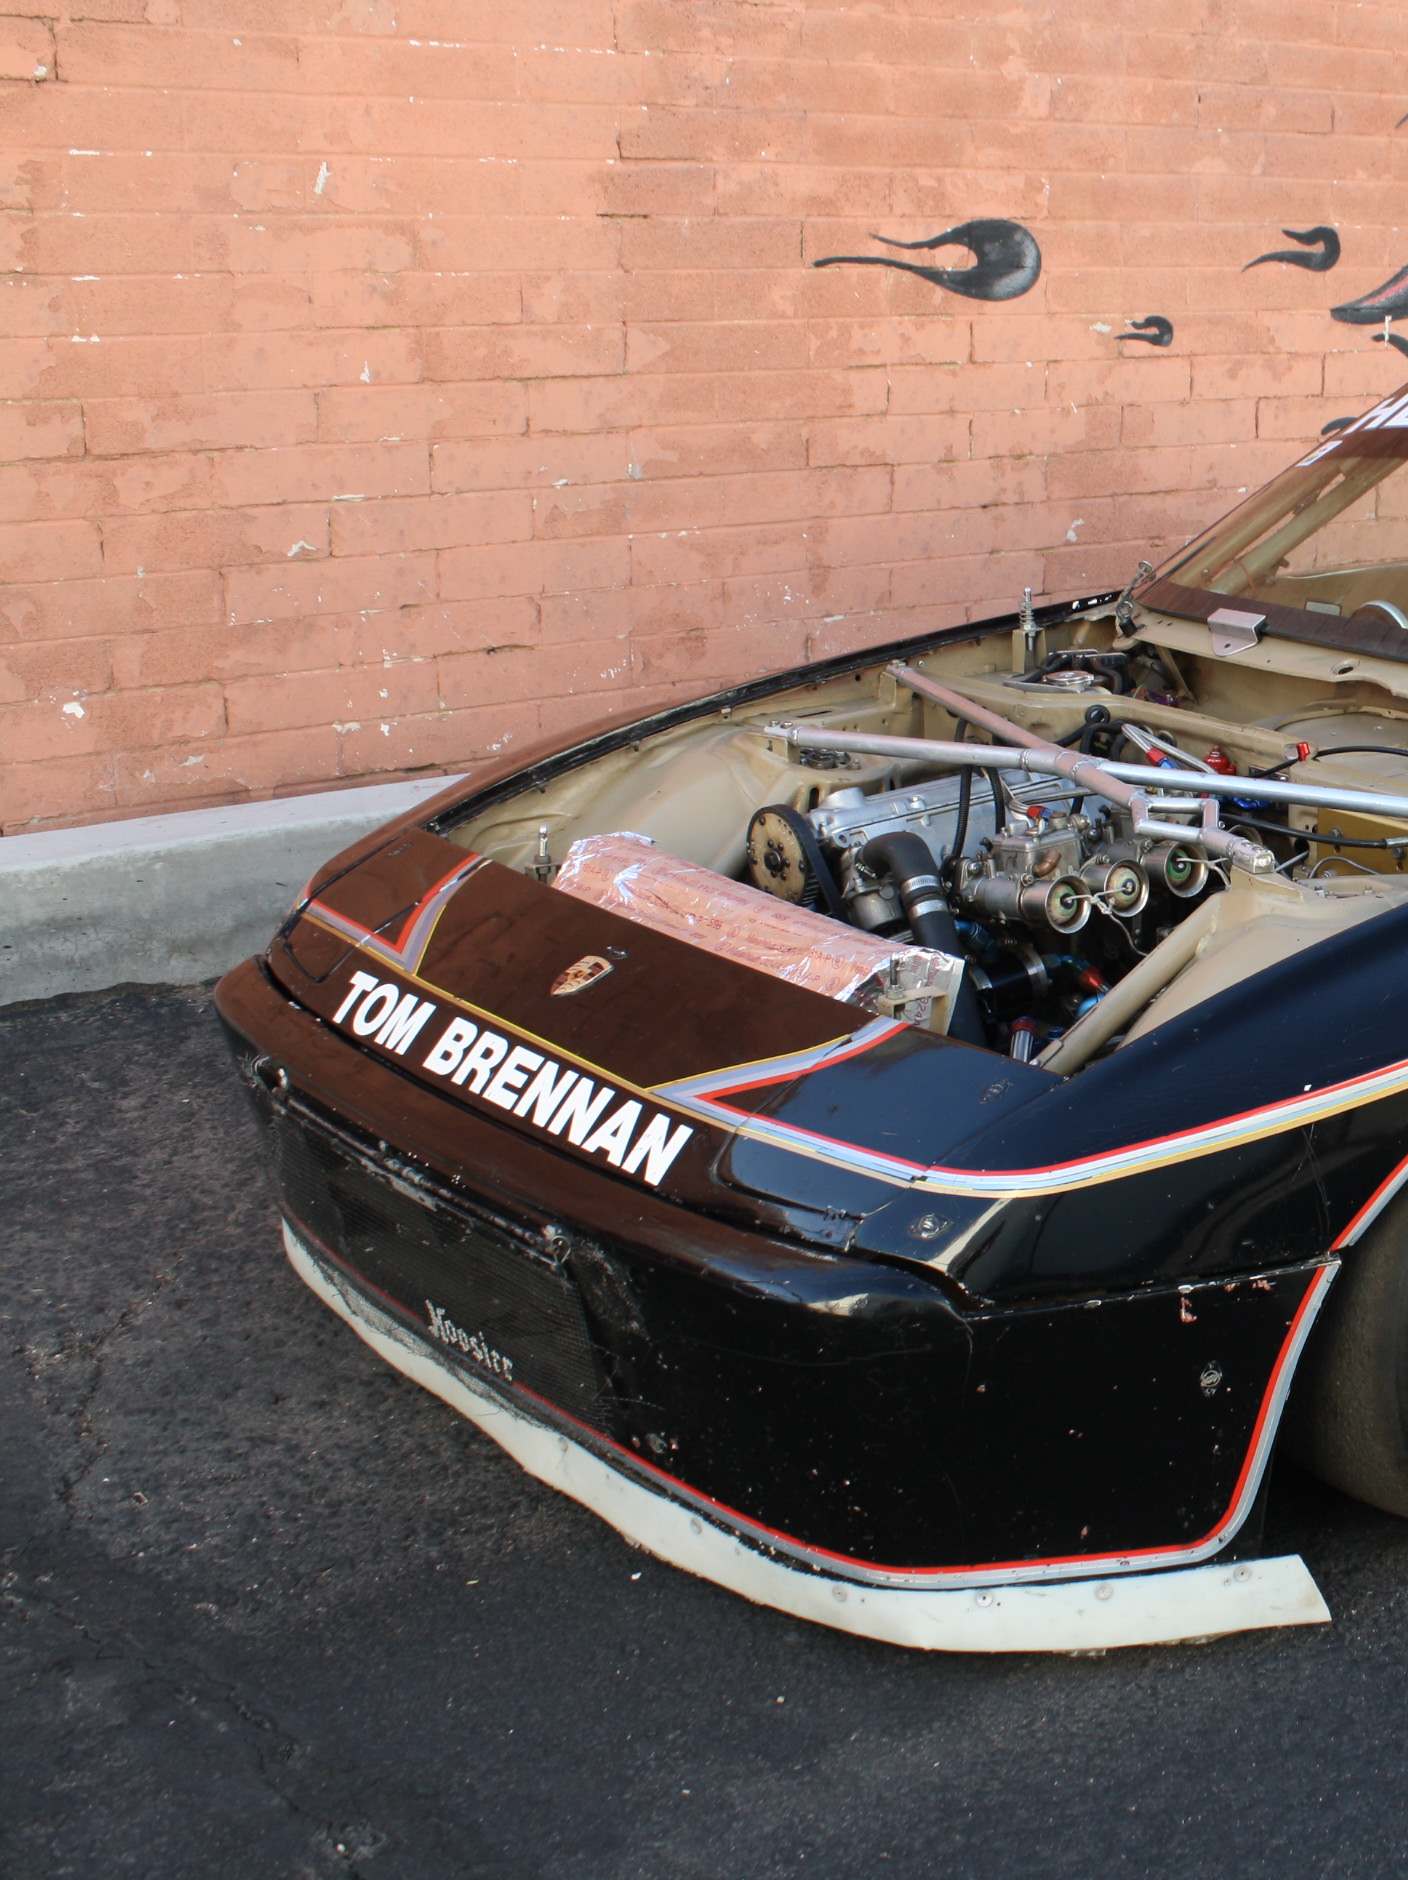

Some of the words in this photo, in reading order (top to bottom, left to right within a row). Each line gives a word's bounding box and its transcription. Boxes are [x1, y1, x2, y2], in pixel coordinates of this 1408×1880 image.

[333, 970, 436, 1056] TOM
[422, 1016, 694, 1187] BRENNAN
[424, 1299, 513, 1381] Hoosier
